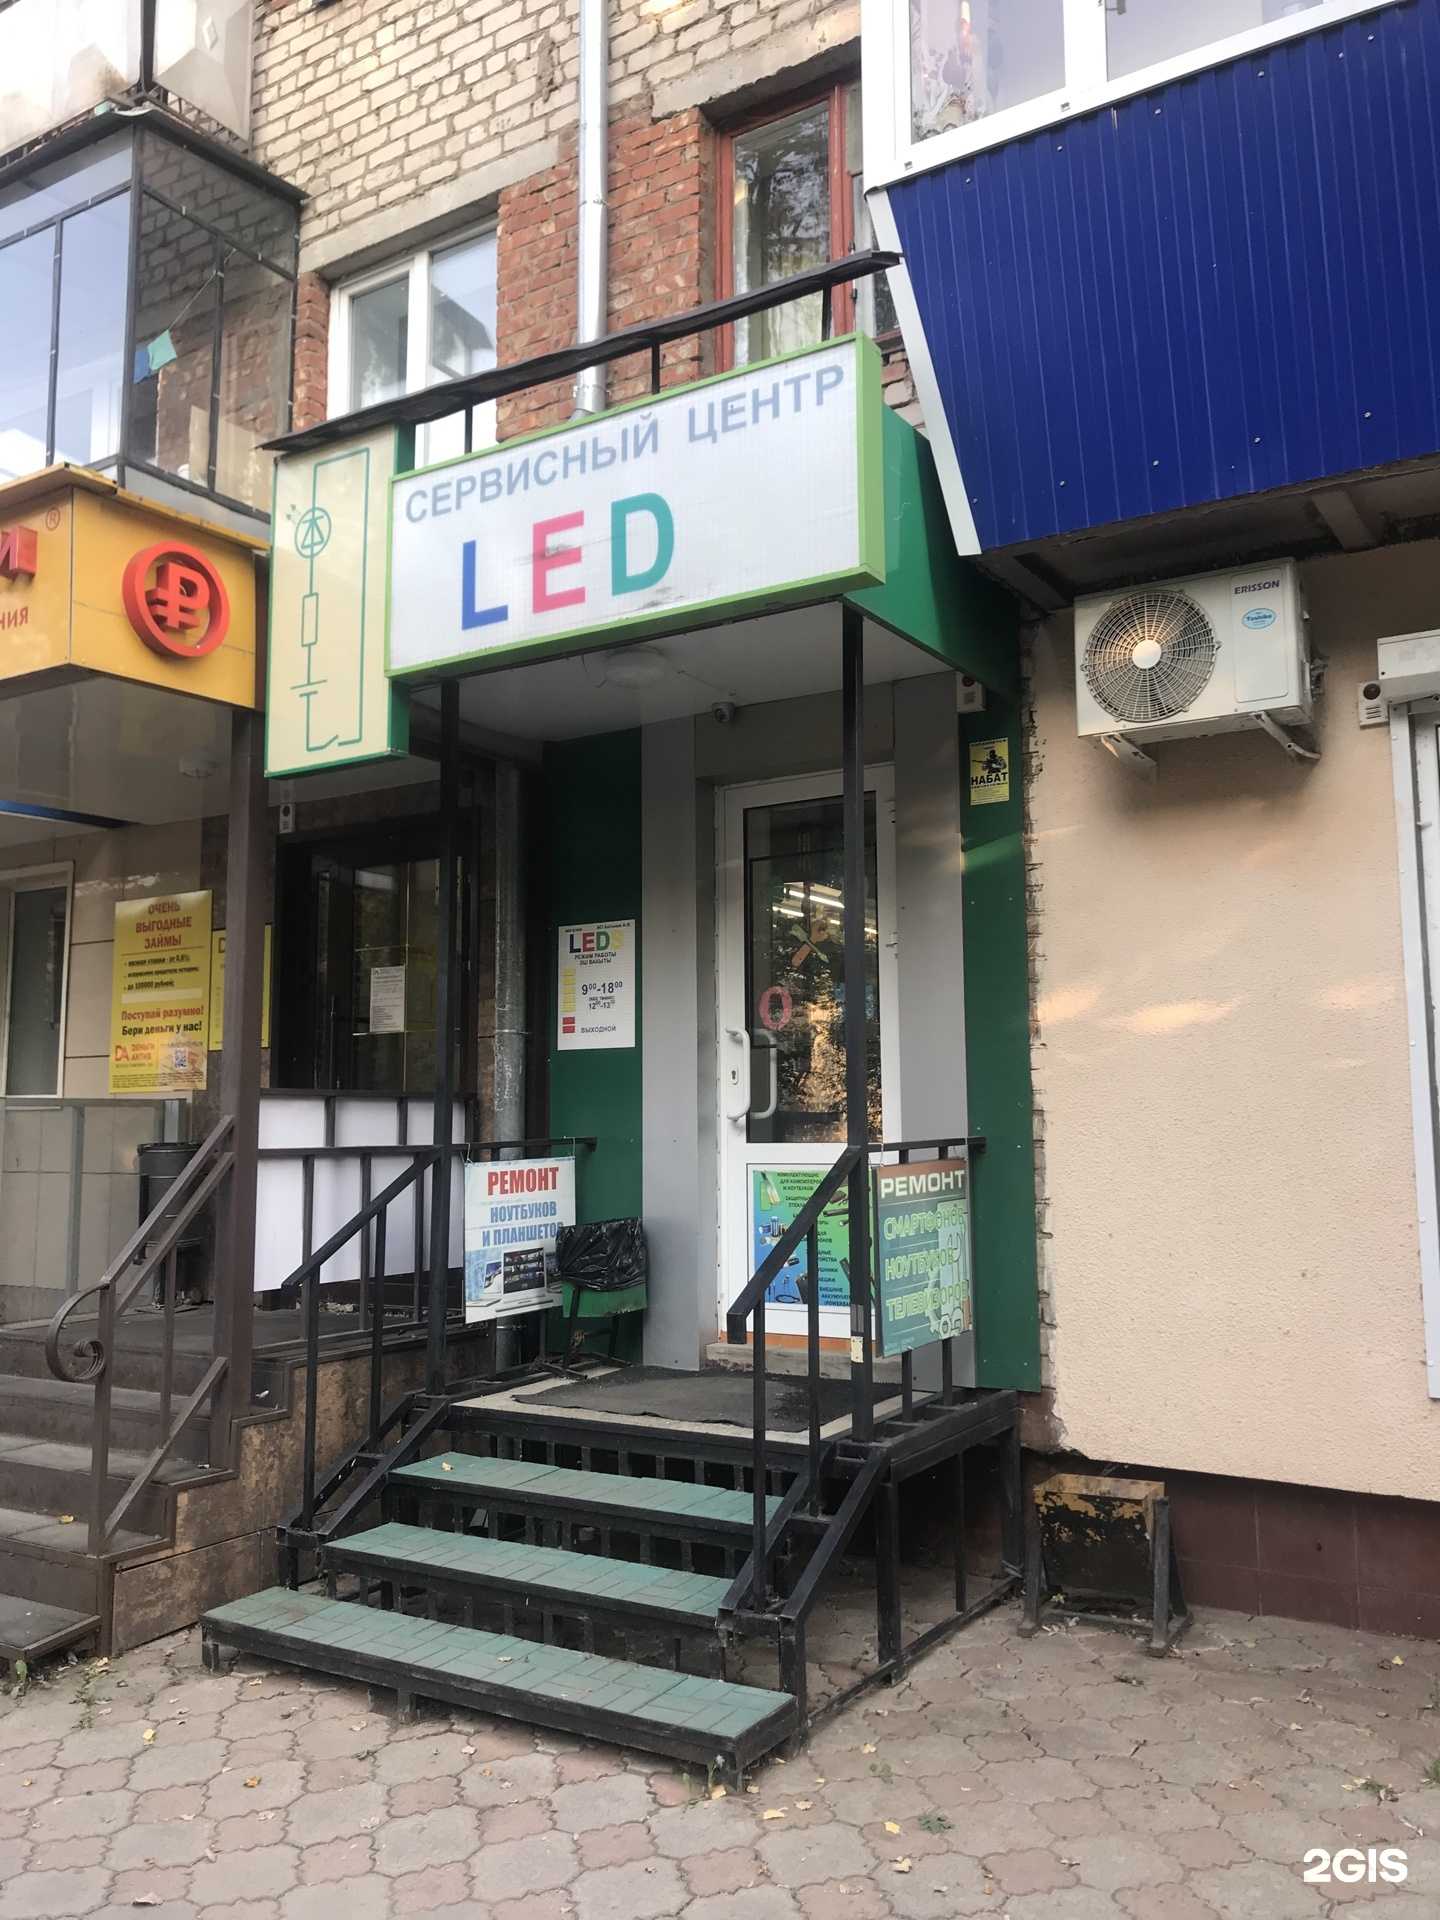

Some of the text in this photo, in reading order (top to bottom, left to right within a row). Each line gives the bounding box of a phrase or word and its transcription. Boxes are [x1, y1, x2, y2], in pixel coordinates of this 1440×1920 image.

[405, 364, 844, 524] СЕРВИСНЫЙ ЦЕНТР
[461, 491, 675, 631] LED
[1234, 580, 1280, 594] ERISSON
[971, 772, 1008, 785] НАБАТ
[148, 901, 181, 914] ОЧЕНЬ
[136, 916, 192, 933] ВЫГОДНЫЕ
[144, 934, 182, 949] ЗАЙМЫ
[569, 931, 610, 953] LED
[121, 1005, 204, 1021] Поступай разумно!
[122, 1021, 202, 1037] Бери деньги у нас!
[581, 1025, 616, 1033] ВЫХОДНОЙ
[487, 1167, 560, 1196] РЕМОНТ
[881, 1170, 965, 1199] РЕМОНТ
[490, 1201, 557, 1223] НОУТБУКОВ
[482, 1231, 490, 1247] И
[885, 1247, 955, 1281] НОУТБУКОВ
[886, 1280, 969, 1322] ТЕЛЕВИЗОРОВ
